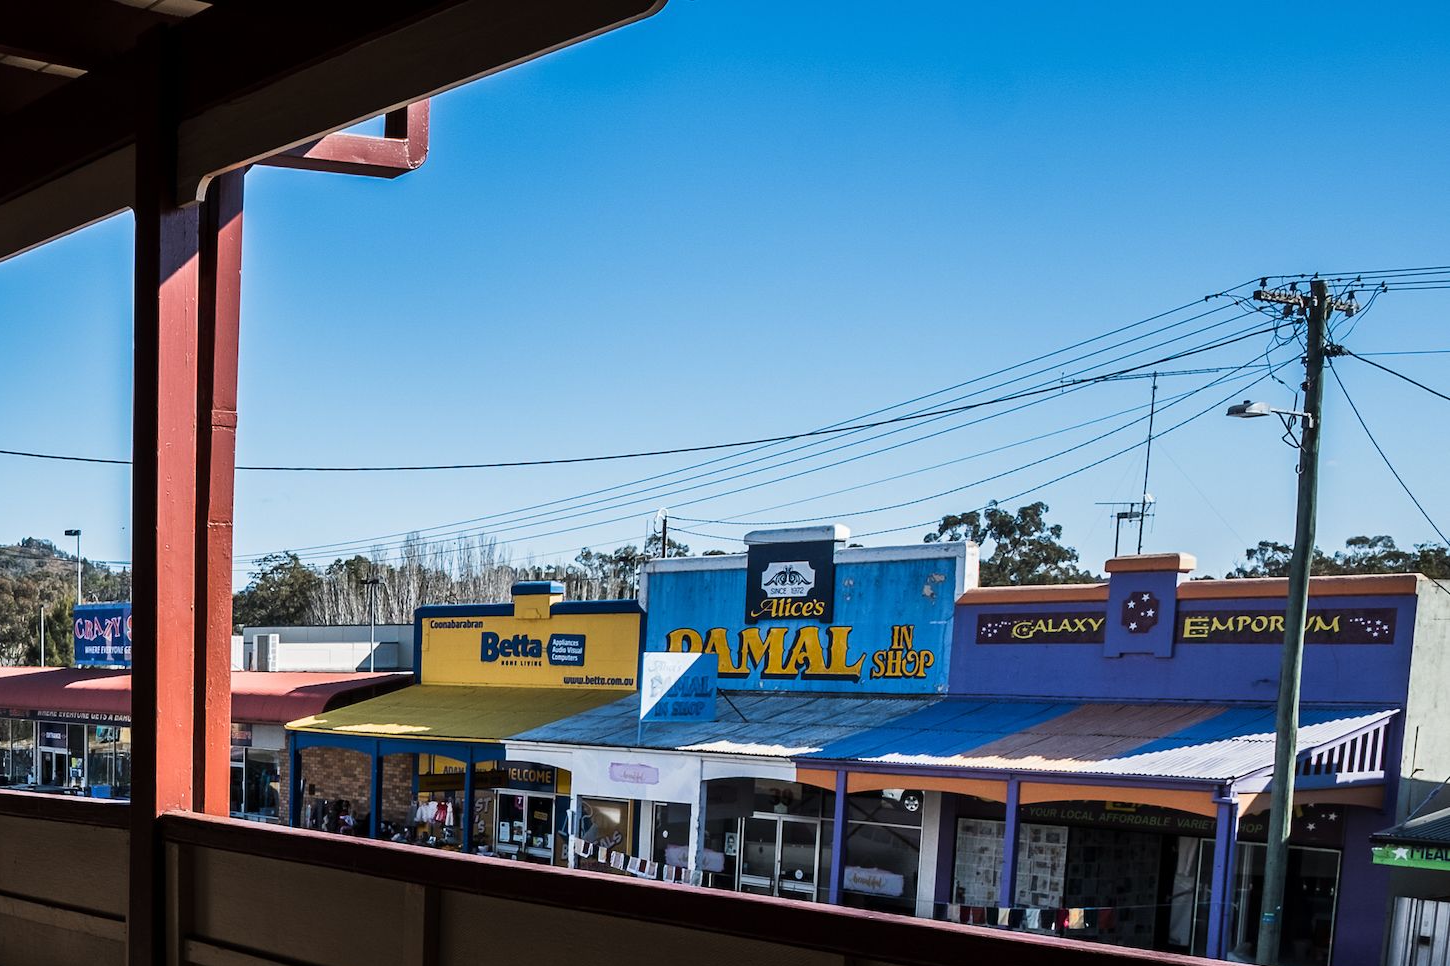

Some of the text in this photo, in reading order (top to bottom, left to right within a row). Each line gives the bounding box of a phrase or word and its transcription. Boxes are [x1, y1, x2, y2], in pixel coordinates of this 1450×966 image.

[770, 587, 787, 595] SINCE
[750, 598, 825, 618] Alice's
[74, 616, 121, 641] CRAZY
[430, 620, 483, 630] Coonabarabran
[1011, 616, 1104, 639] GALAXY
[891, 625, 915, 650] IN
[85, 646, 100, 654] WHERE
[481, 632, 542, 662] Betta
[870, 649, 935, 679] SHOP
[563, 675, 634, 687] www.betta.com.au
[505, 767, 551, 784] ELCOME
[1176, 817, 1217, 831] VARIET
[1238, 824, 1264, 834] HOP
